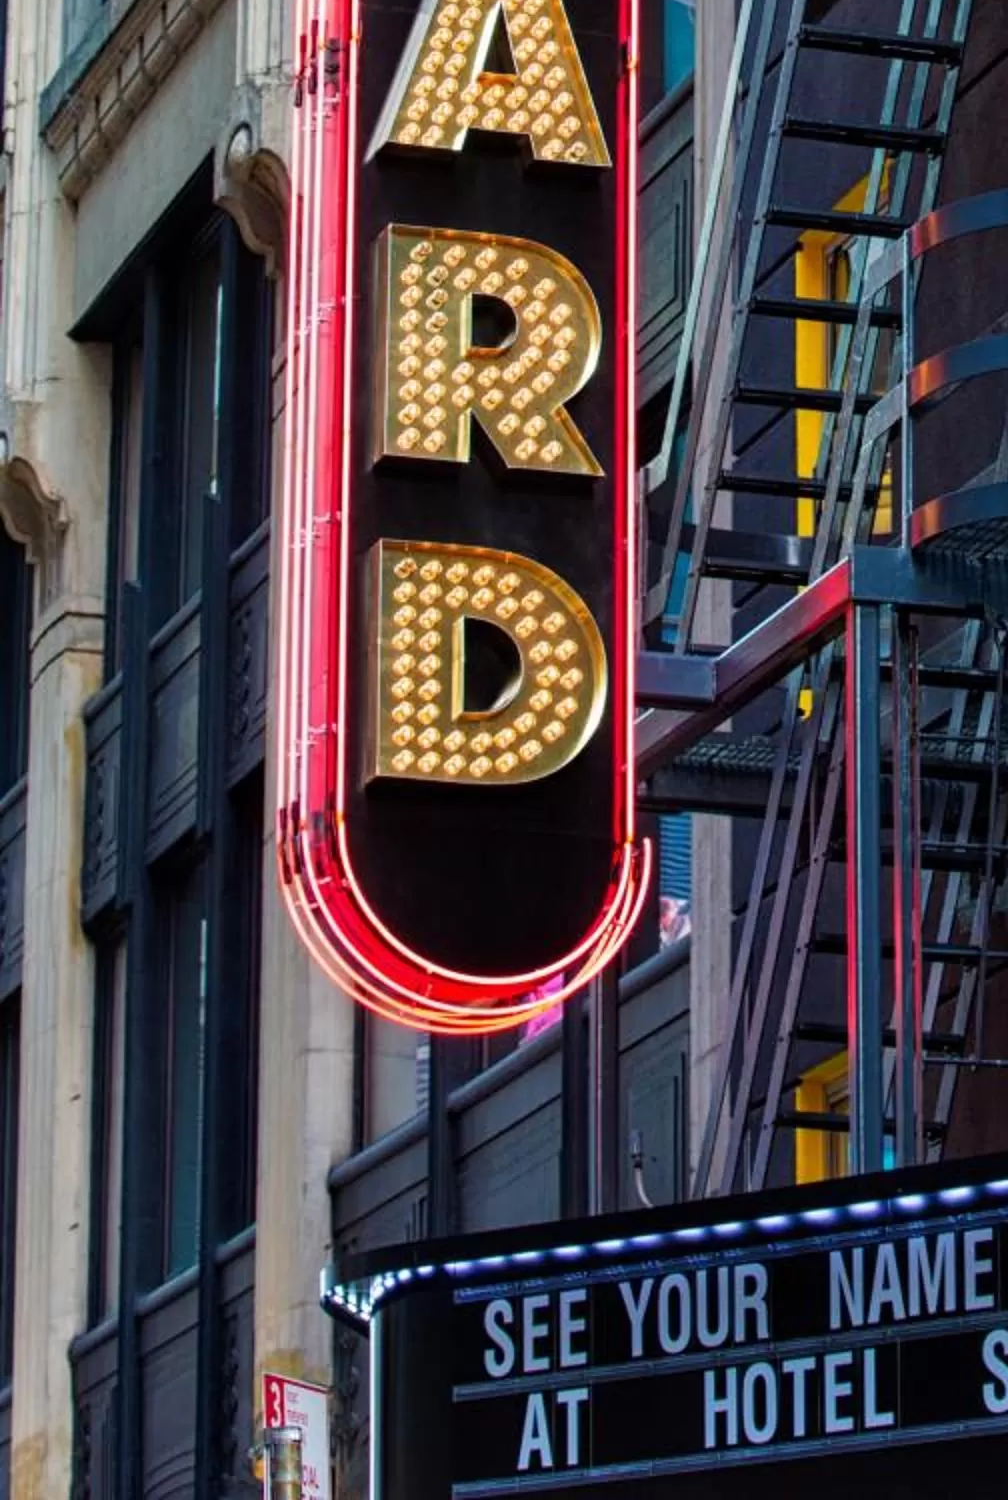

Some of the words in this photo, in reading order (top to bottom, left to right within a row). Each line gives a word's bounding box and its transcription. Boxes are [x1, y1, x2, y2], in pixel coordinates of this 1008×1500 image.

[483, 1289, 588, 1378] SEE
[619, 1262, 769, 1357] YOUR
[829, 1227, 995, 1330] NAME
[270, 1381, 282, 1428] 3
[517, 1388, 589, 1471] AT
[704, 1348, 895, 1449] HOTEL
